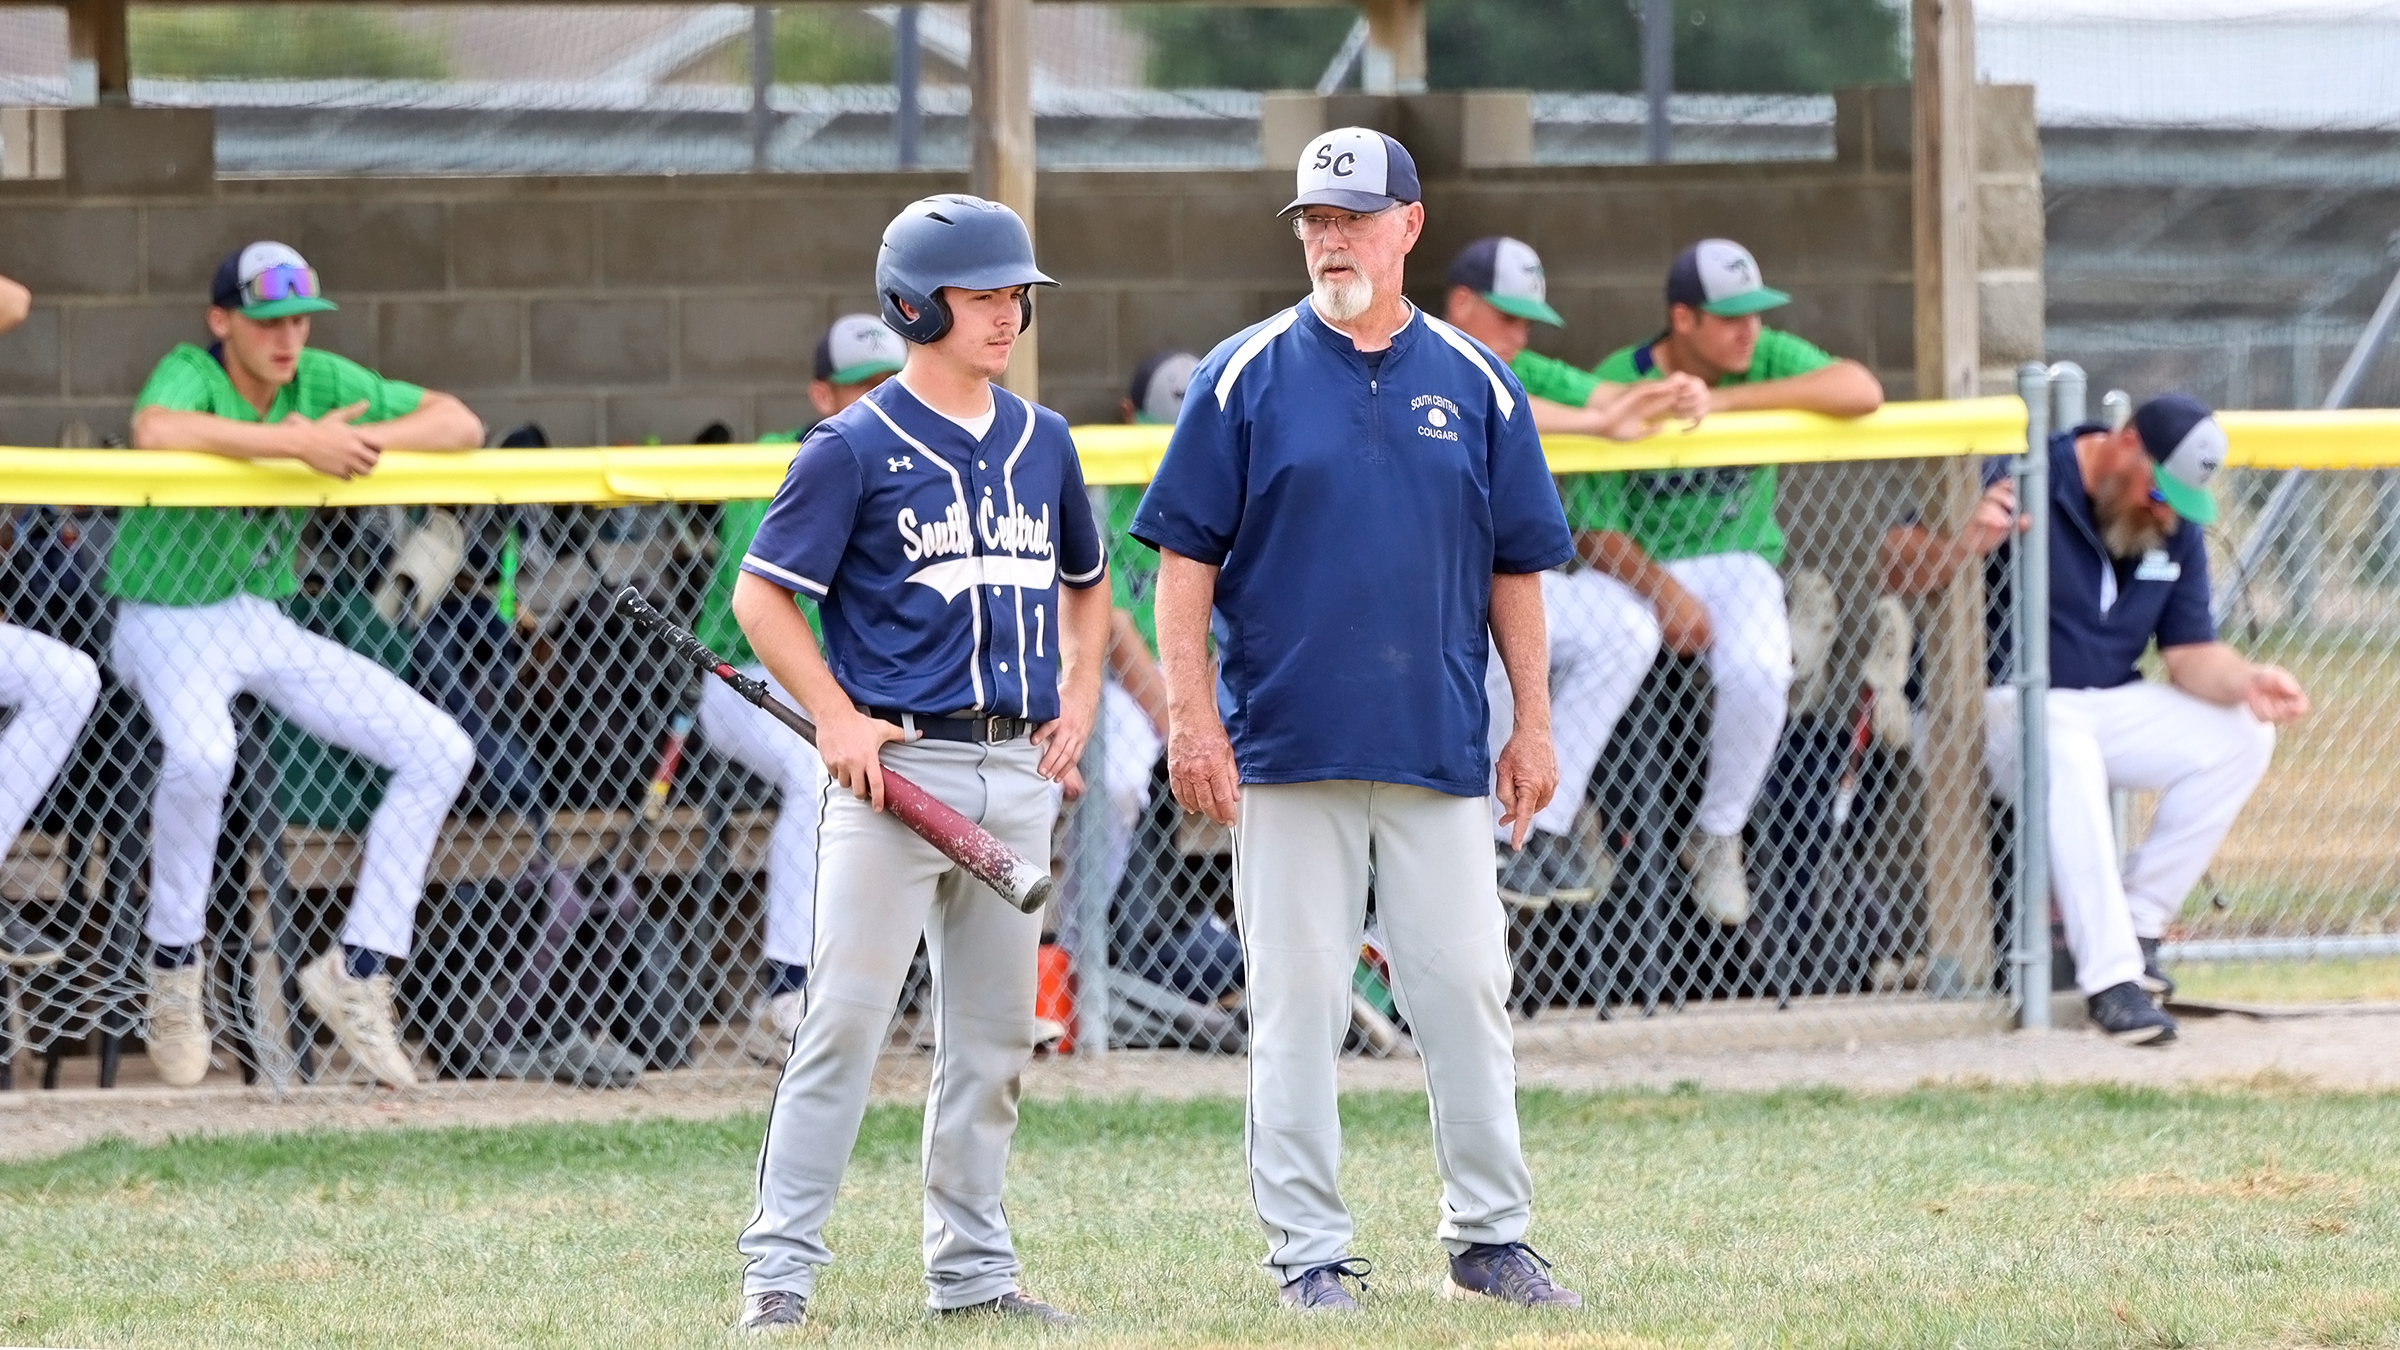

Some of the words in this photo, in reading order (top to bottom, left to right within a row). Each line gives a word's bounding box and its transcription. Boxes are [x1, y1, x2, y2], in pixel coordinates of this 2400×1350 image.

[1312, 143, 1355, 177] SC
[1411, 394, 1432, 411] SOUTH
[1432, 395, 1461, 420] CENTRAL
[1417, 425, 1458, 442] COUGARS
[897, 502, 974, 562] South
[980, 496, 1054, 556] Central
[1034, 603, 1044, 658] 1
